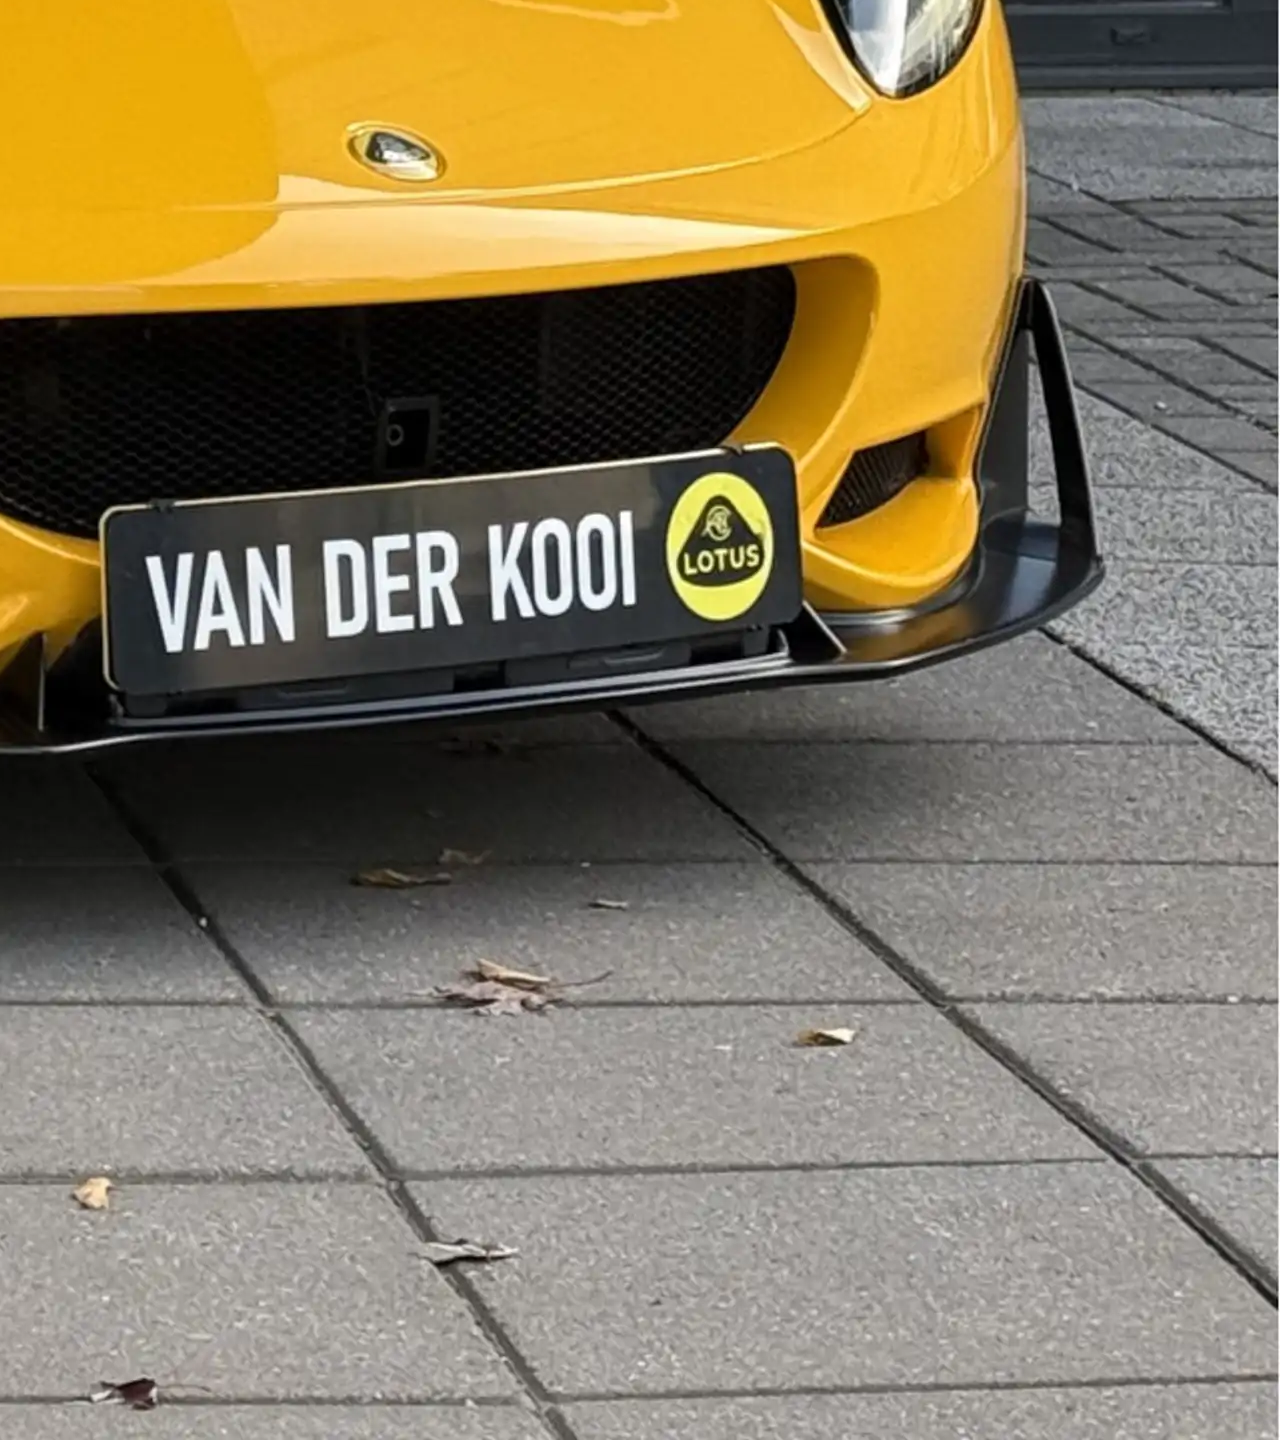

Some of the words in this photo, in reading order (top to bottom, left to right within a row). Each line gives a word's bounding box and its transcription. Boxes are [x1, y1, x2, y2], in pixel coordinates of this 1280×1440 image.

[146, 544, 296, 654] VAN
[322, 530, 464, 640] DER
[487, 509, 638, 623] KOOI
[683, 543, 760, 576] LOTUS
